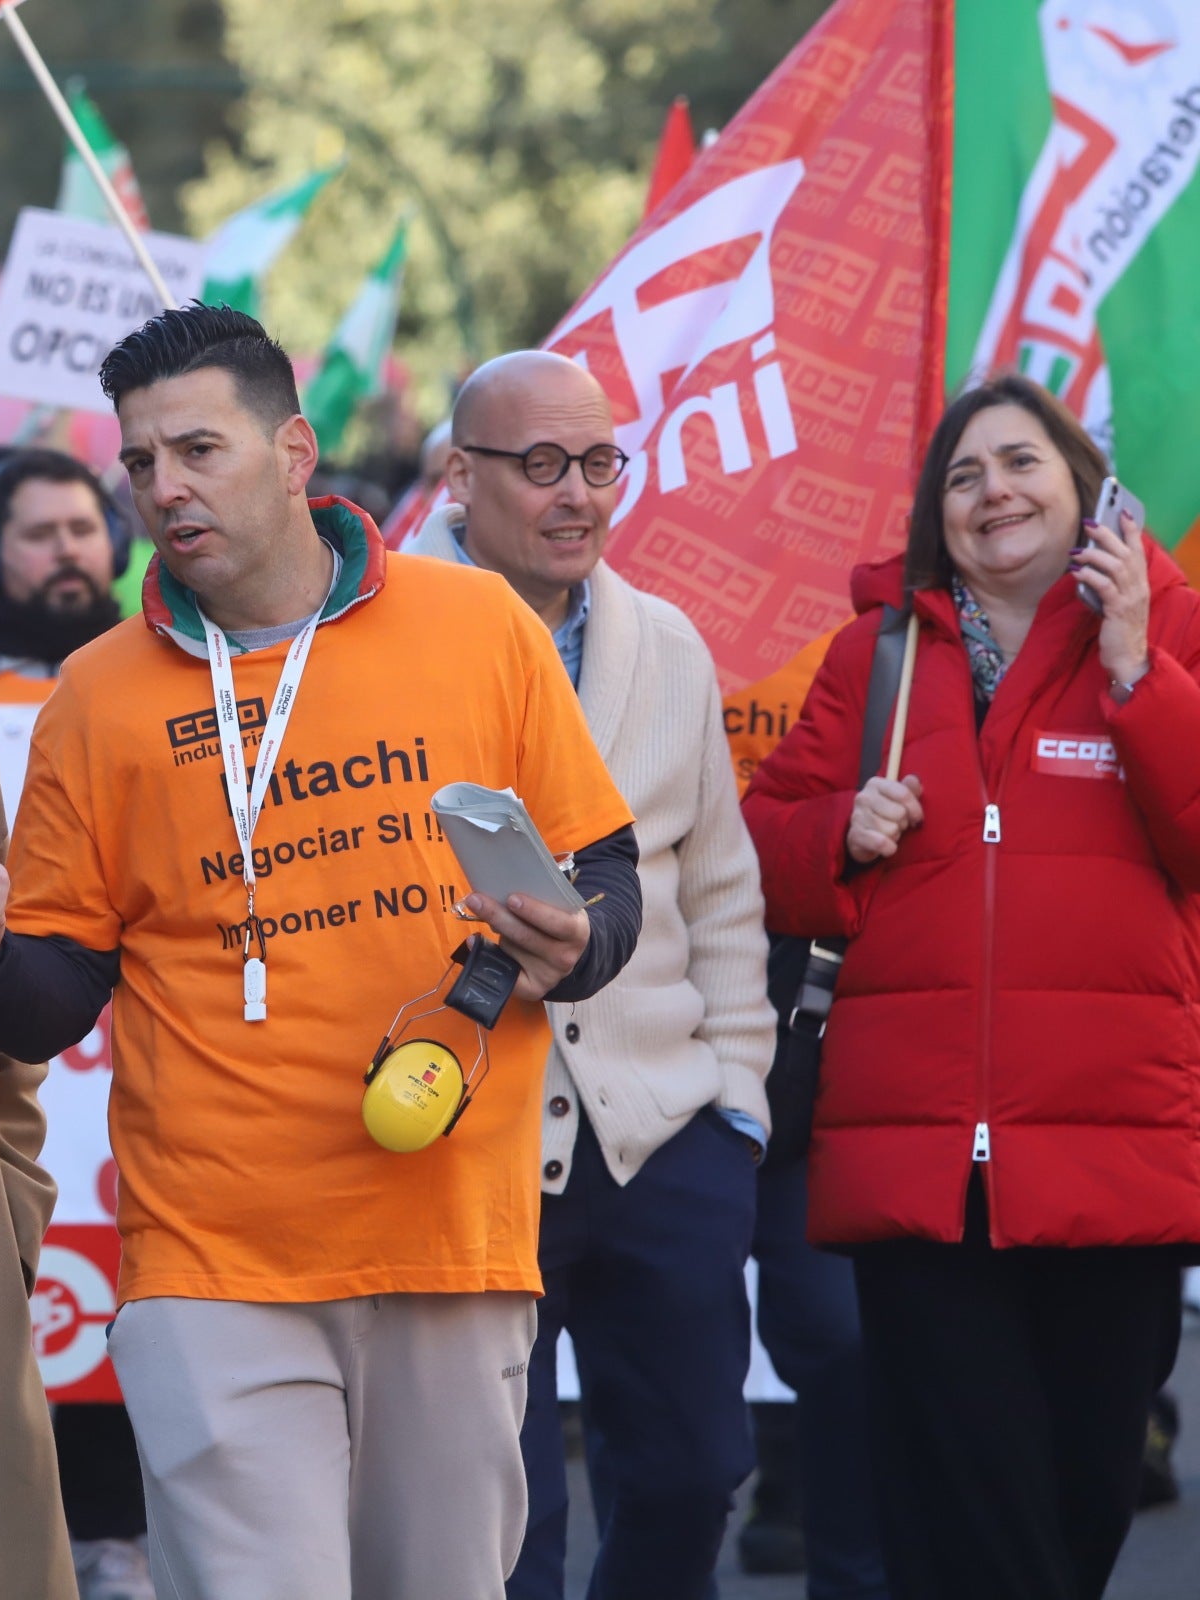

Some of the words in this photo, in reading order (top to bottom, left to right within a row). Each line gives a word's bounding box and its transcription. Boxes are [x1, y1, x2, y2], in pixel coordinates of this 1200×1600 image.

[27, 269, 75, 306] NO
[79, 276, 111, 314] ES
[9, 322, 104, 374] OPC
[224, 690, 234, 721] HITACHI
[280, 685, 293, 716] HITACHI
[170, 700, 264, 744] CCO
[173, 730, 264, 767] induri
[200, 825, 365, 885] Negociar
[377, 812, 413, 844] SI
[373, 884, 428, 918] NO
[428, 1061, 442, 1073] 3M
[407, 1074, 440, 1098] PELTOR
